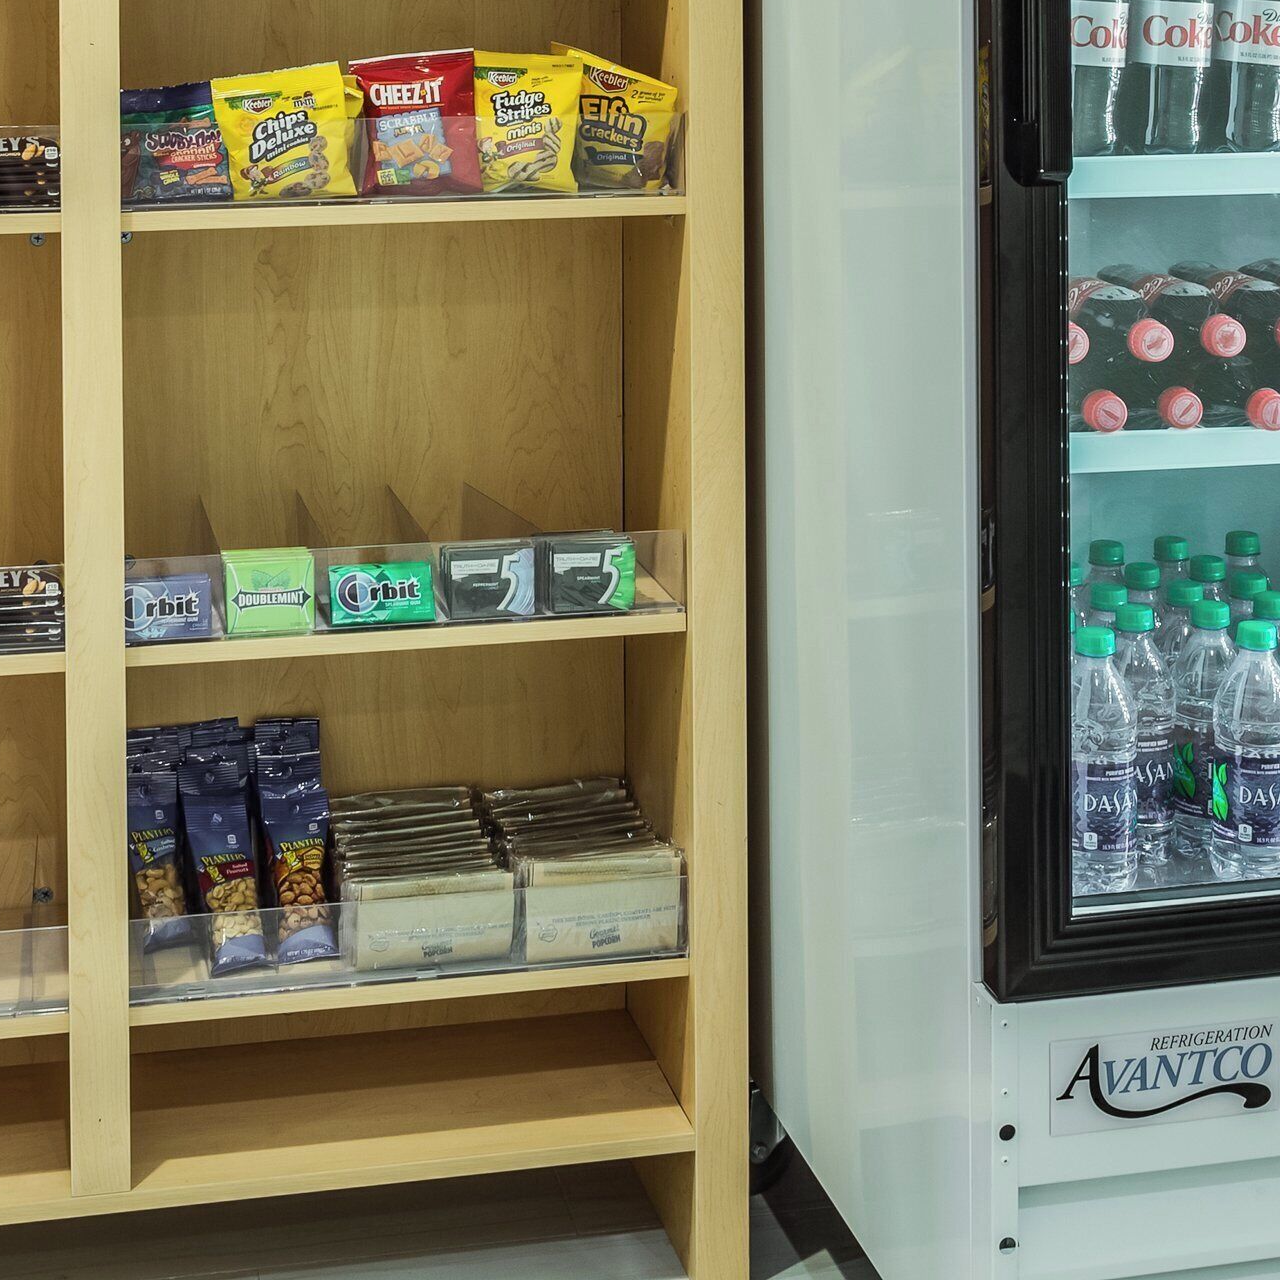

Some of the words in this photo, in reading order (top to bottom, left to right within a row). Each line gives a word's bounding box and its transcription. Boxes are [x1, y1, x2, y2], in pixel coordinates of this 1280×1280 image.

[489, 72, 517, 85] Keebler
[244, 98, 272, 111] Keebler
[493, 92, 543, 110] Fudge
[379, 113, 438, 131] SCRABBLE
[496, 103, 550, 126] Stripes
[581, 98, 642, 136] Elfin
[256, 112, 305, 139] Chips
[507, 122, 541, 140] minis
[252, 124, 314, 160] Deluxe
[582, 124, 639, 148] Crackers
[506, 140, 536, 153] Original
[272, 160, 306, 179] Rainbow
[497, 555, 520, 610] 5
[598, 548, 623, 604] 5
[239, 590, 304, 606] DOUBLEMINT
[338, 572, 420, 614] Orbit
[125, 585, 199, 631] Orbit
[131, 827, 174, 842] PLANTERS
[280, 838, 324, 852] PLANTERS
[201, 852, 246, 866] PLANTERS
[592, 935, 621, 948] POPCORN
[1149, 1024, 1273, 1053] REFRIGERATION
[1055, 1042, 1273, 1119] AVANTCO
